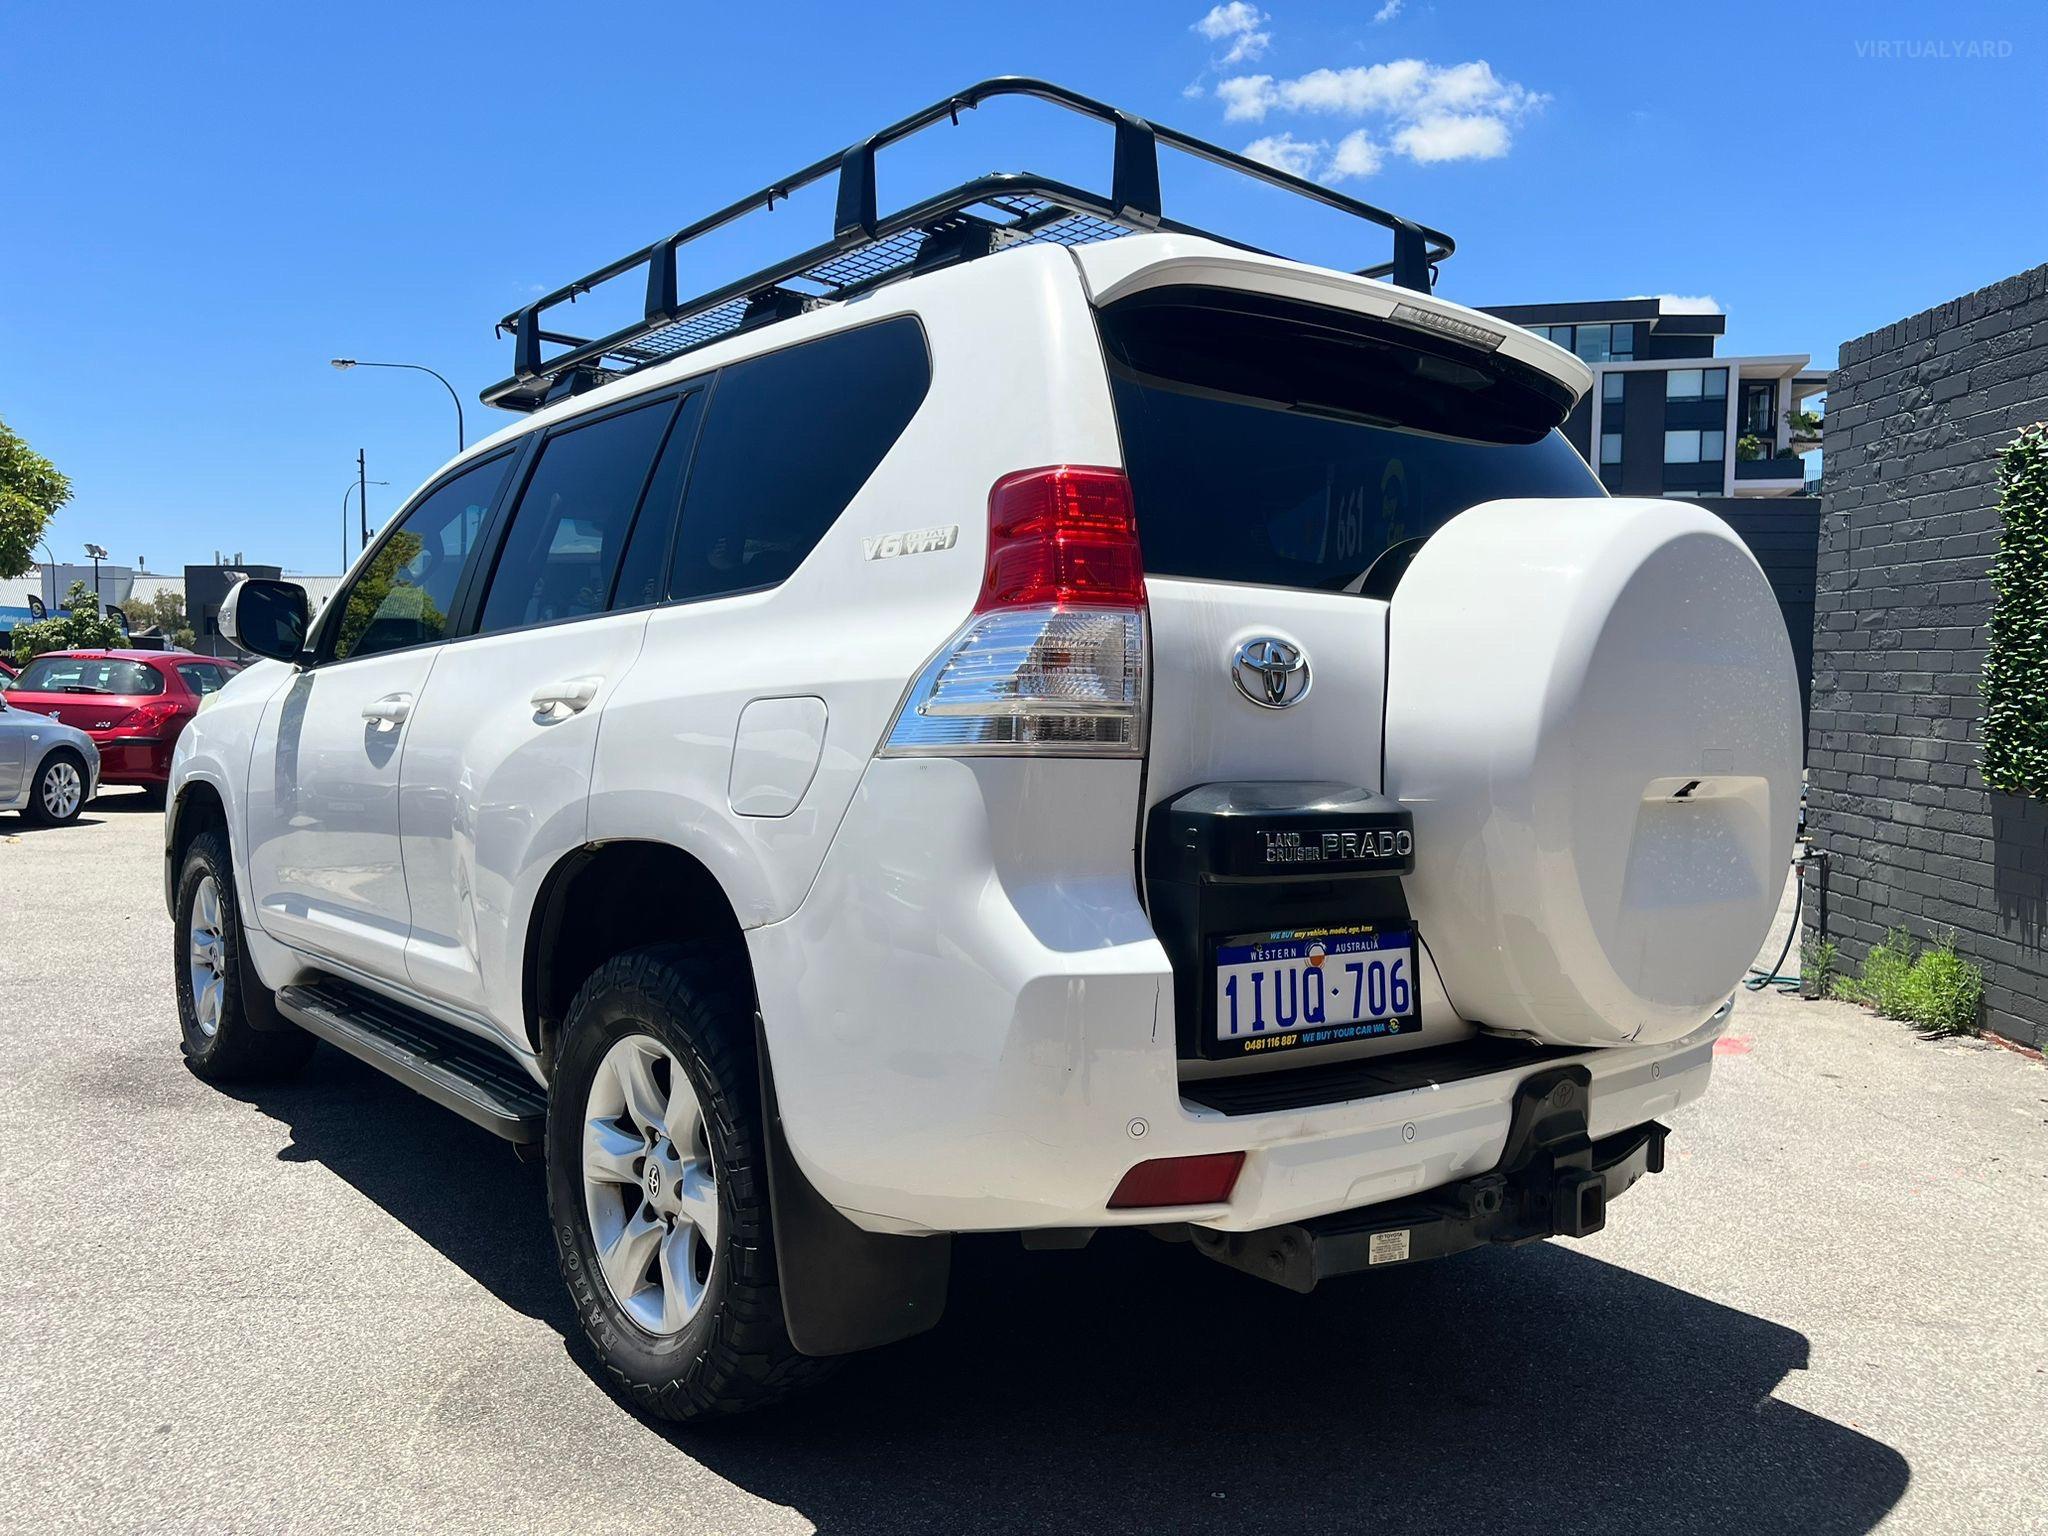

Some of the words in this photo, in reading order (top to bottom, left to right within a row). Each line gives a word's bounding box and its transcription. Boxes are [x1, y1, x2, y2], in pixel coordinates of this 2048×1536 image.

[863, 534, 901, 561] V6
[1265, 832, 1300, 848] LAND
[1321, 830, 1412, 860] PRADO
[1266, 846, 1320, 862] CRUISER
[1281, 931, 1294, 939] BUY
[1294, 931, 1306, 939] any
[1250, 948, 1297, 961] WESTERN
[1335, 940, 1379, 953] AUSTRALIA
[1225, 966, 1326, 1034] 1IUQ
[1345, 958, 1409, 1019] 706
[1244, 1038, 1265, 1051] 0481
[1266, 1037, 1281, 1048] 116
[1281, 1034, 1298, 1046] 887
[1302, 1032, 1315, 1043] WE
[1316, 1030, 1332, 1041] BUY
[1333, 1027, 1355, 1038] YOUR
[1355, 1025, 1372, 1036] CAR
[1373, 1023, 1385, 1033] WA
